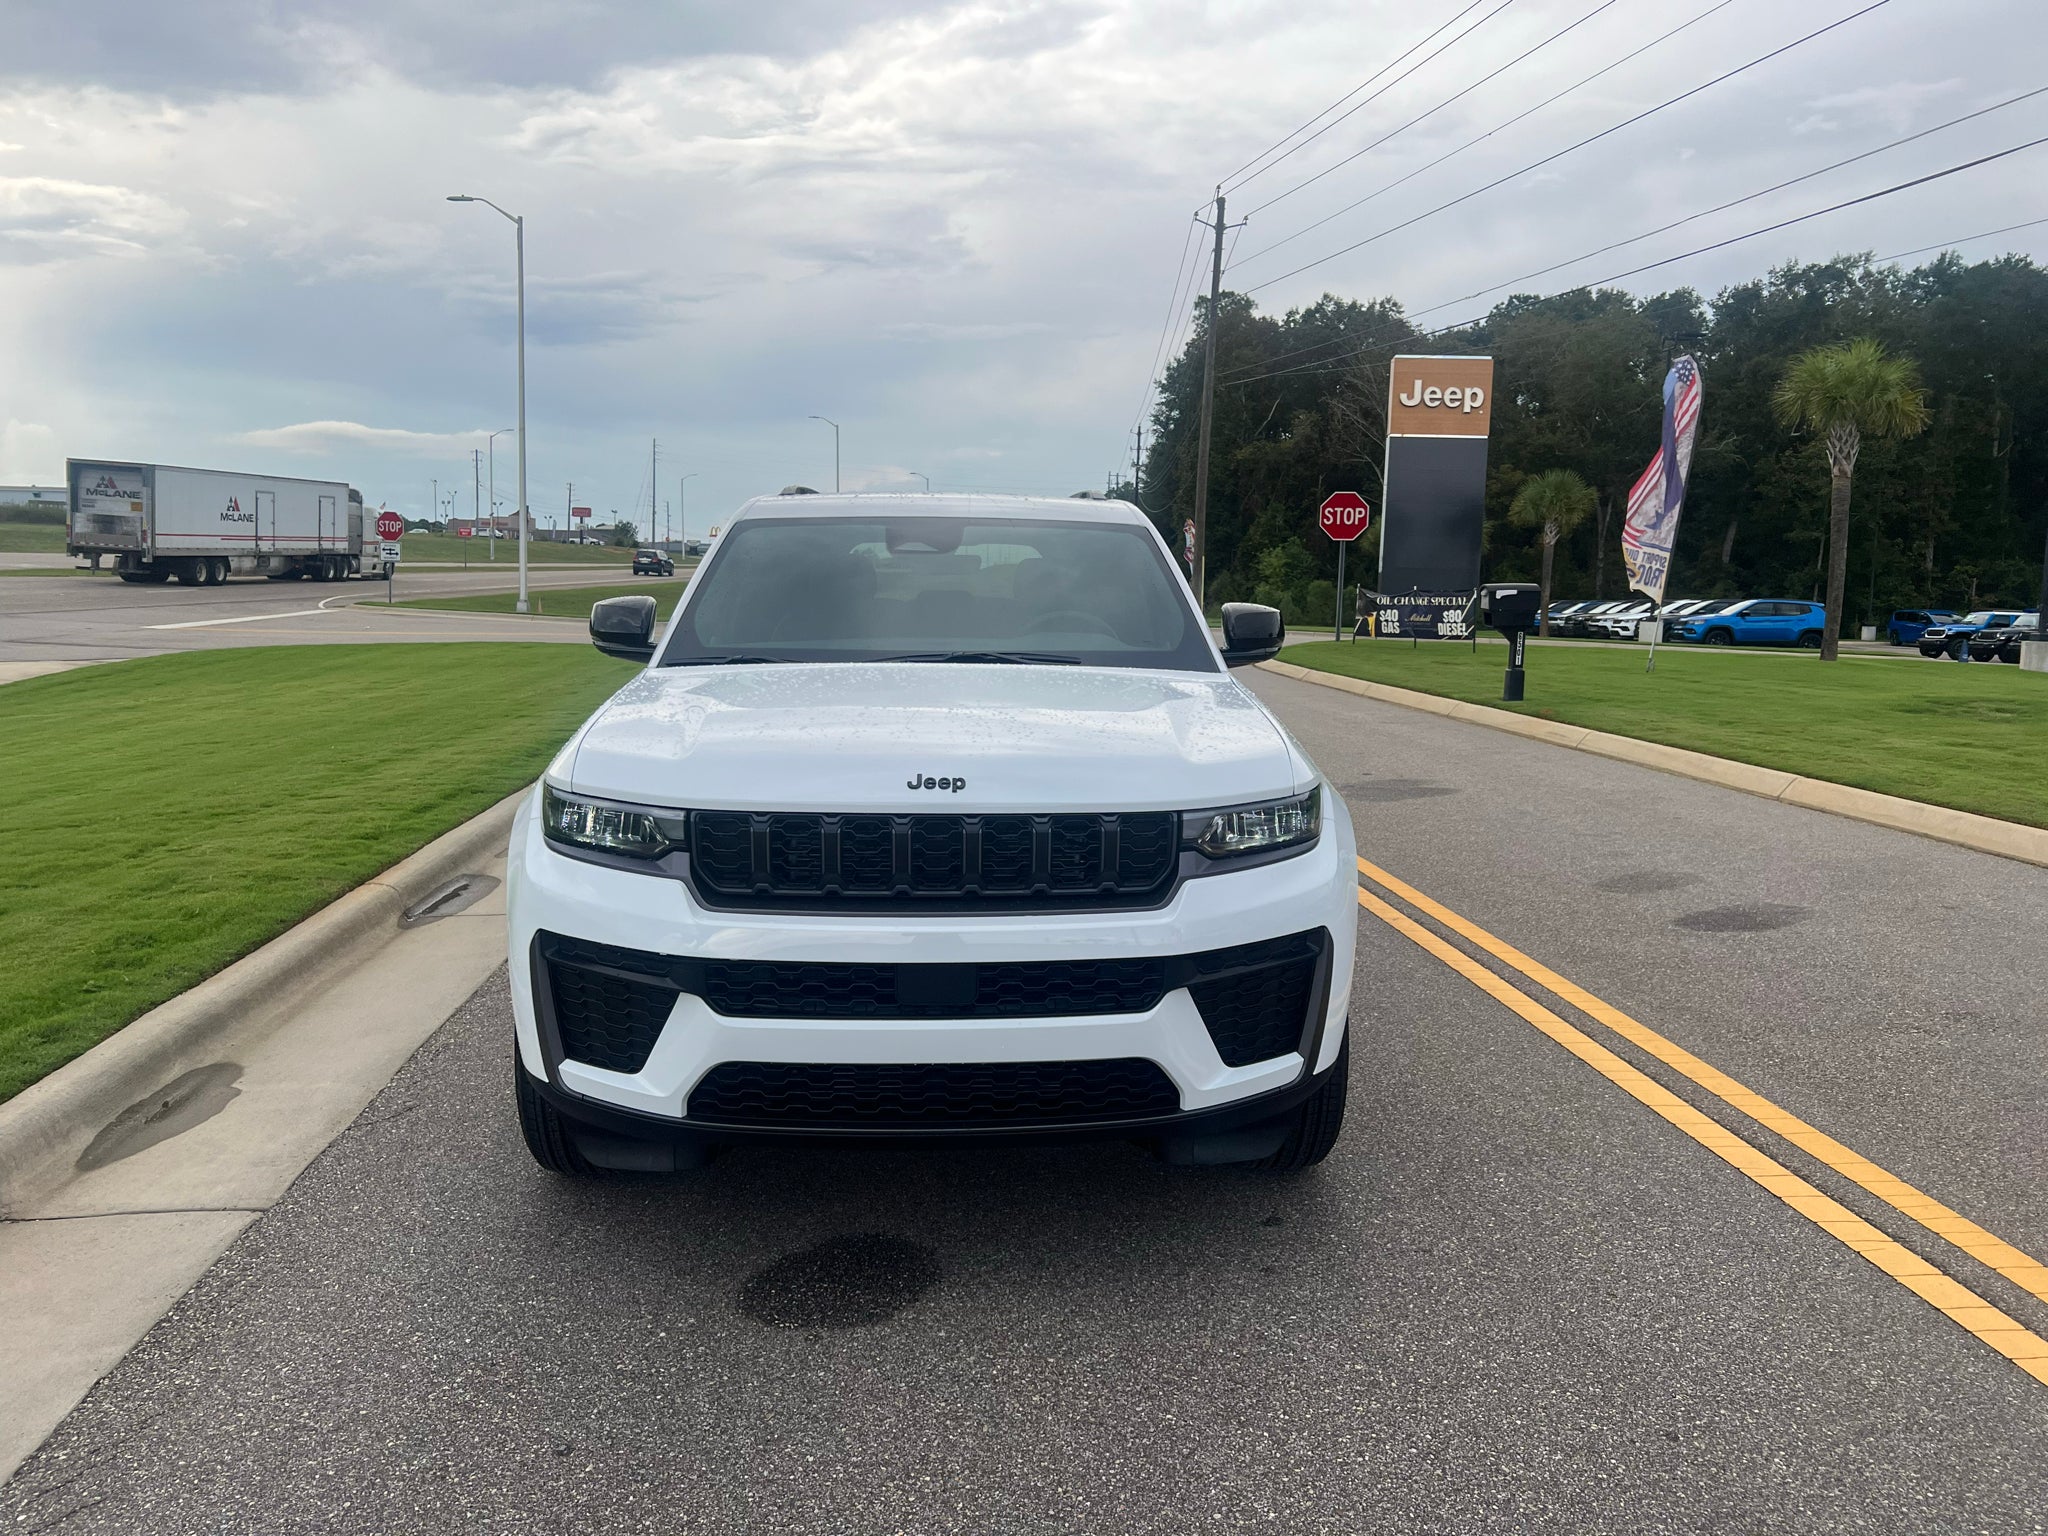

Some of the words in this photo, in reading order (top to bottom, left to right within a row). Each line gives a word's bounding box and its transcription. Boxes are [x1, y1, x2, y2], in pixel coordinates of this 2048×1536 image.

[1399, 379, 1485, 413] Jeep
[220, 512, 254, 522] McLANE
[1323, 507, 1366, 525] STOP
[378, 520, 402, 533] STOP
[1376, 596, 1392, 605] OIL
[1394, 596, 1430, 606] CHANGE
[1430, 596, 1469, 606] SPECIAL
[1379, 609, 1399, 622] $40
[1381, 622, 1400, 634] GAS
[1437, 622, 1468, 636] DIESEL
[906, 773, 967, 793] Jeep
